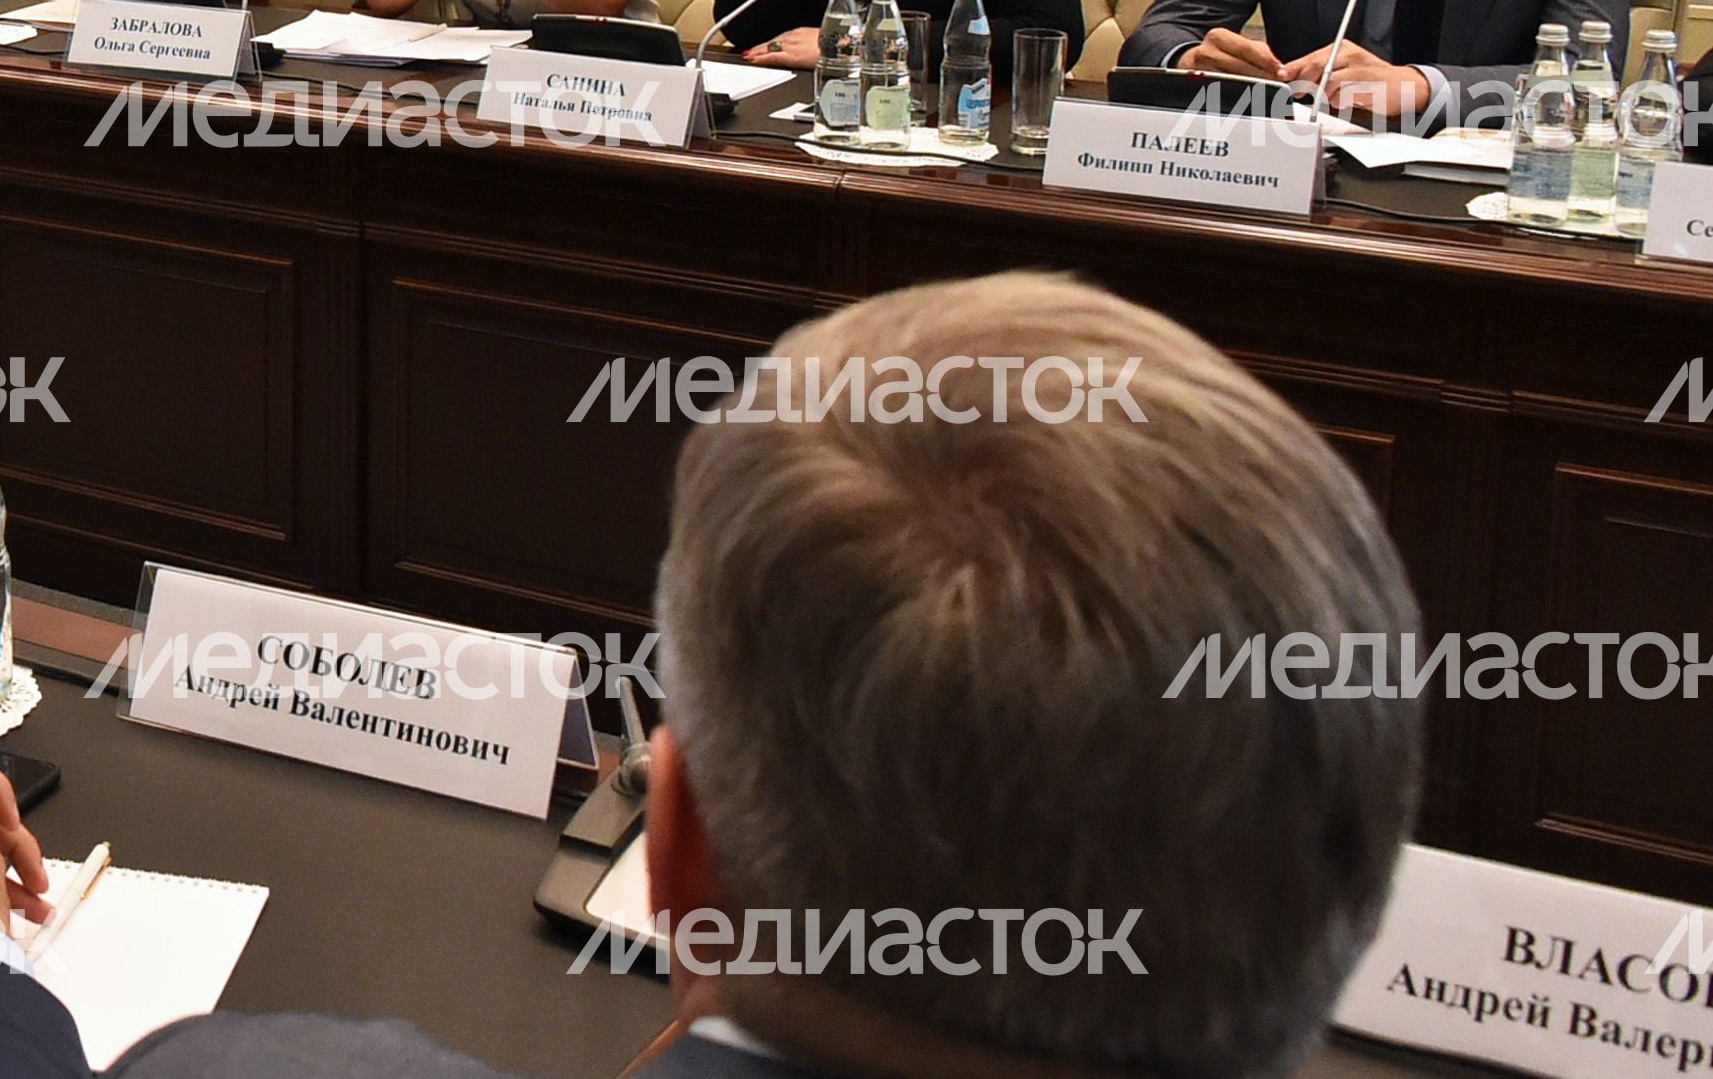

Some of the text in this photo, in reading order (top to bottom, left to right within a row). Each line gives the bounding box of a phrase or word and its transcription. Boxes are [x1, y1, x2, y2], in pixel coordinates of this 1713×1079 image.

[110, 17, 202, 38] ЗАБРАЛОВА
[94, 36, 211, 60] Ольга Сергеевна
[546, 74, 626, 97] САНИНА
[514, 92, 653, 122] Наталья Петровна
[1131, 132, 1230, 157] ПАЛЕЕВ
[1077, 152, 1278, 188] Филипп Николаевич
[257, 634, 439, 701] СОБОЛЕВ
[175, 665, 511, 766] Андрей Валентинович
[1503, 925, 1713, 1008] ВЛАСО
[1387, 963, 1713, 1072] Андрей Валер
